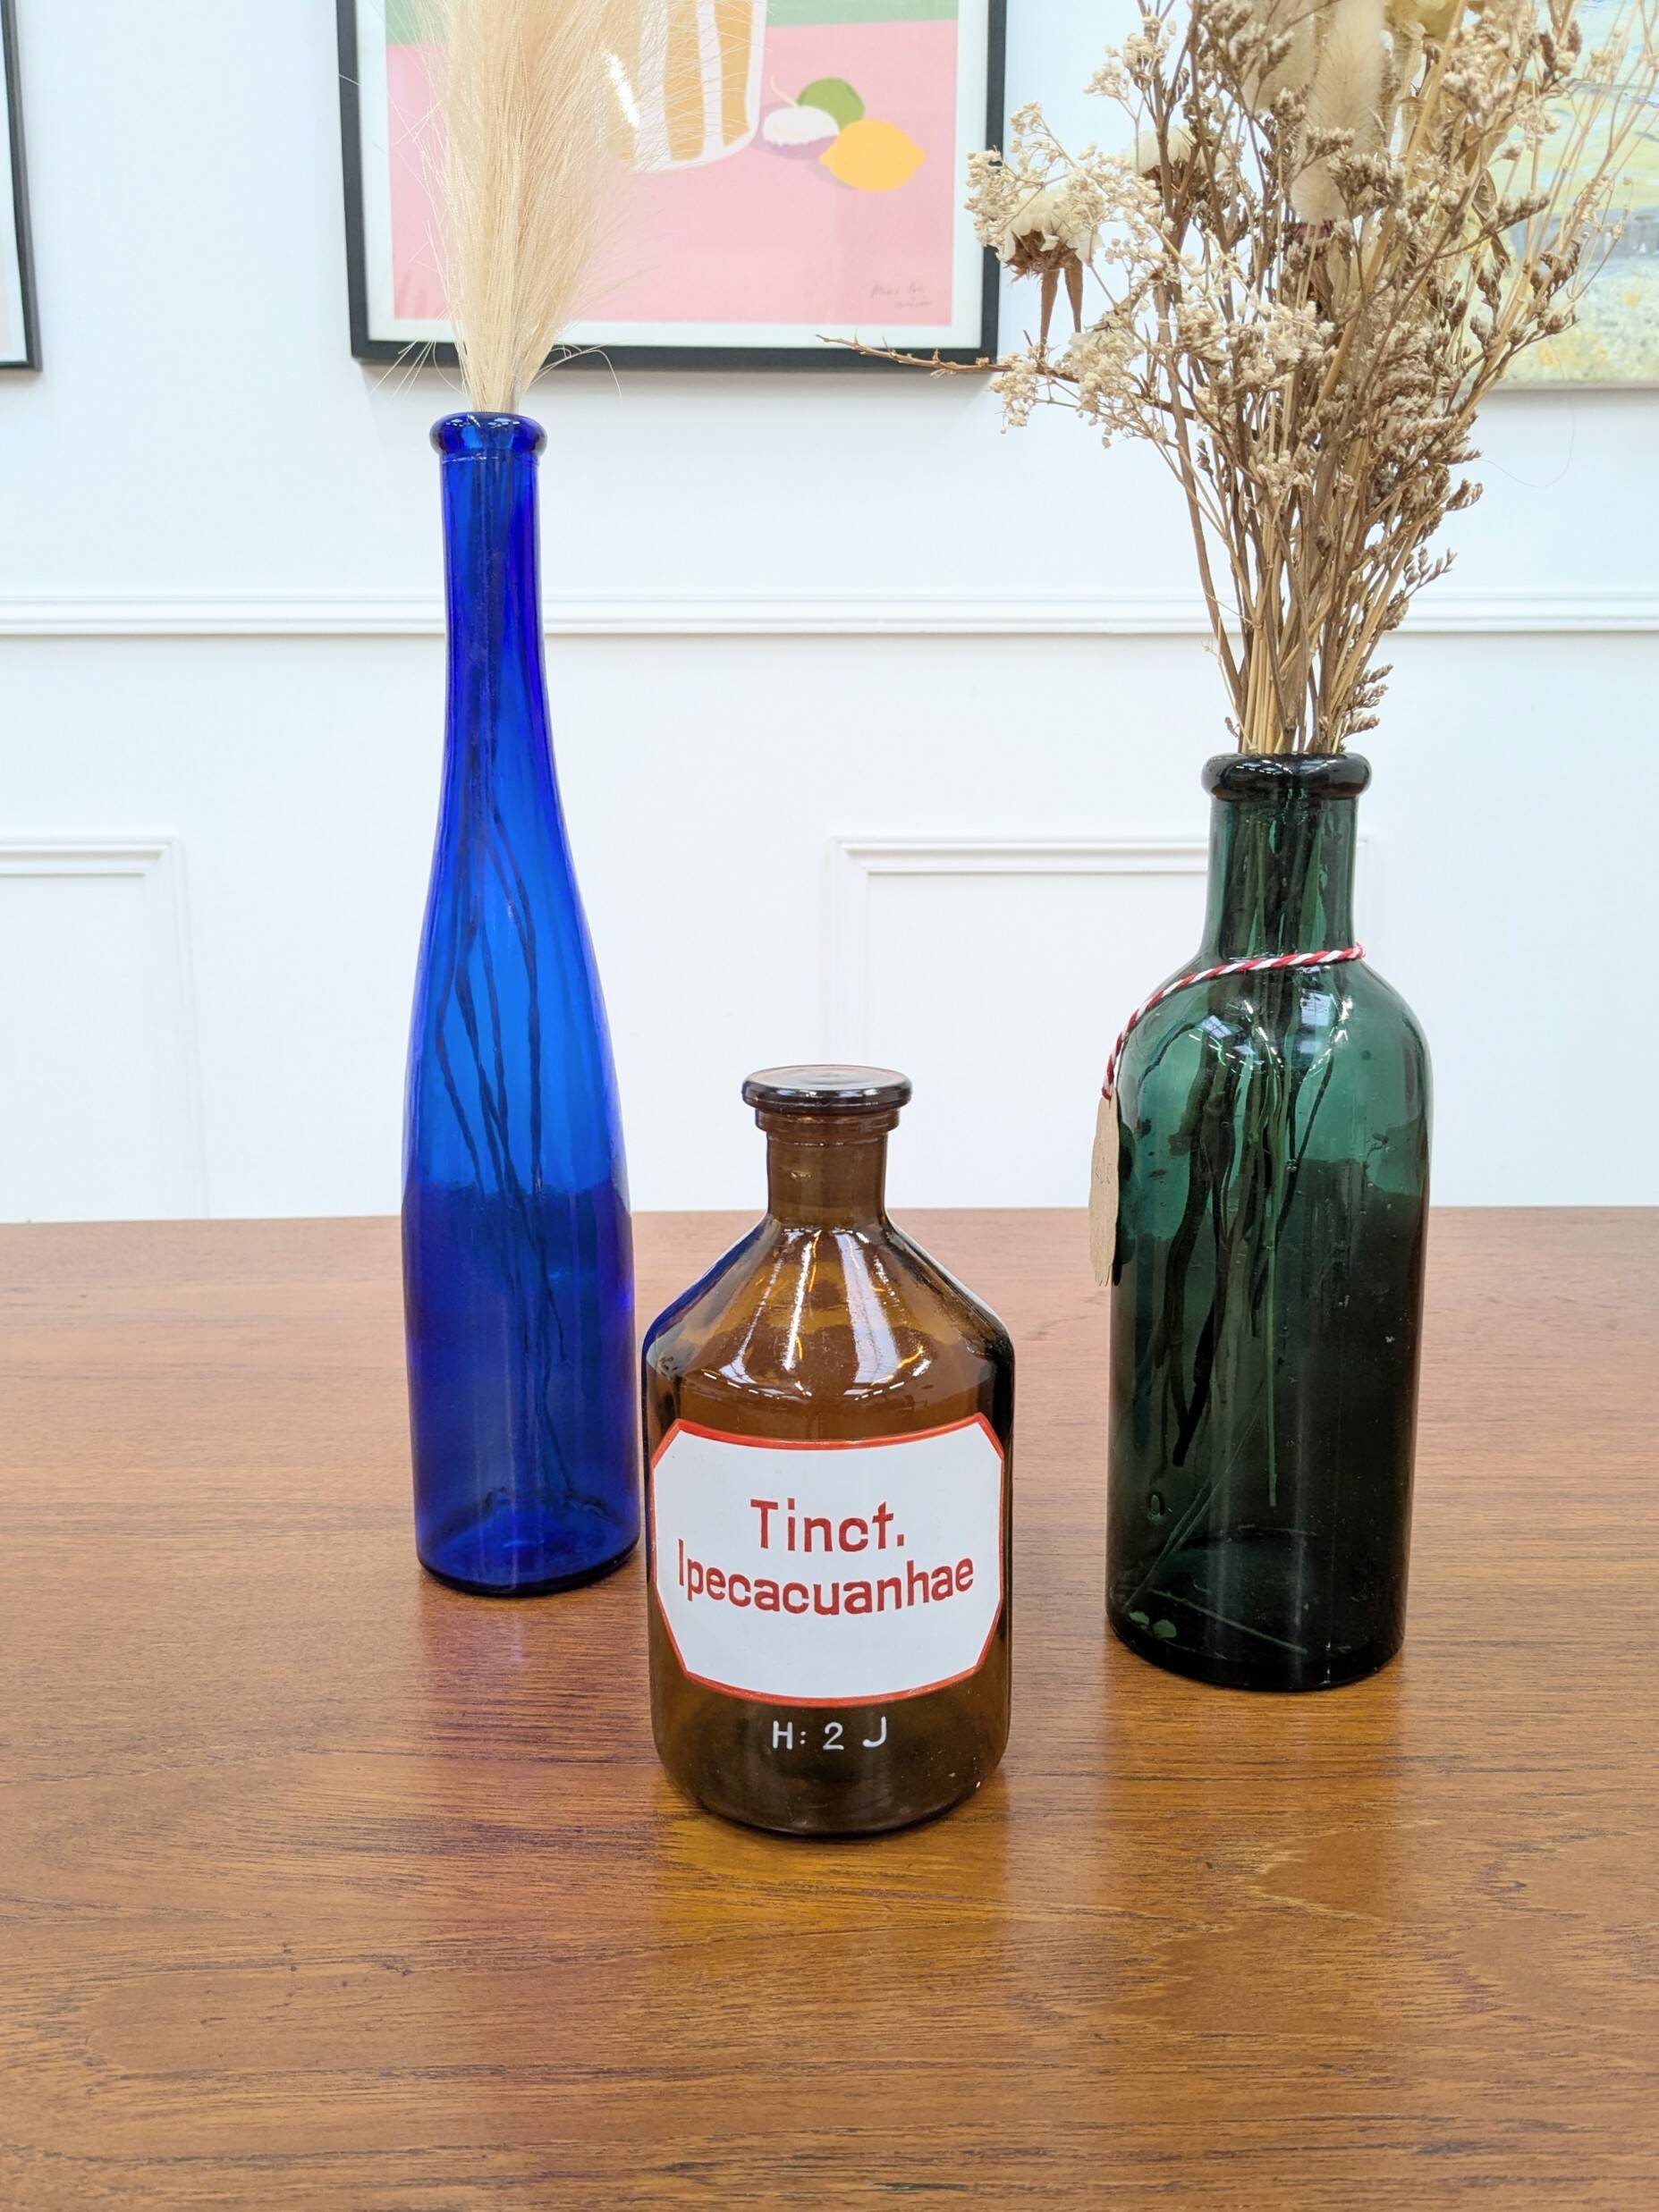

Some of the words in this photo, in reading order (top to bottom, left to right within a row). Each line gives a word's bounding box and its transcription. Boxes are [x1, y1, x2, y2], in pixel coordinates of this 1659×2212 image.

[749, 1497, 905, 1553] Tinct.
[678, 1538, 975, 1617] Ipecacuanhae
[822, 1720, 845, 1751] 2
[862, 1715, 888, 1749] J
